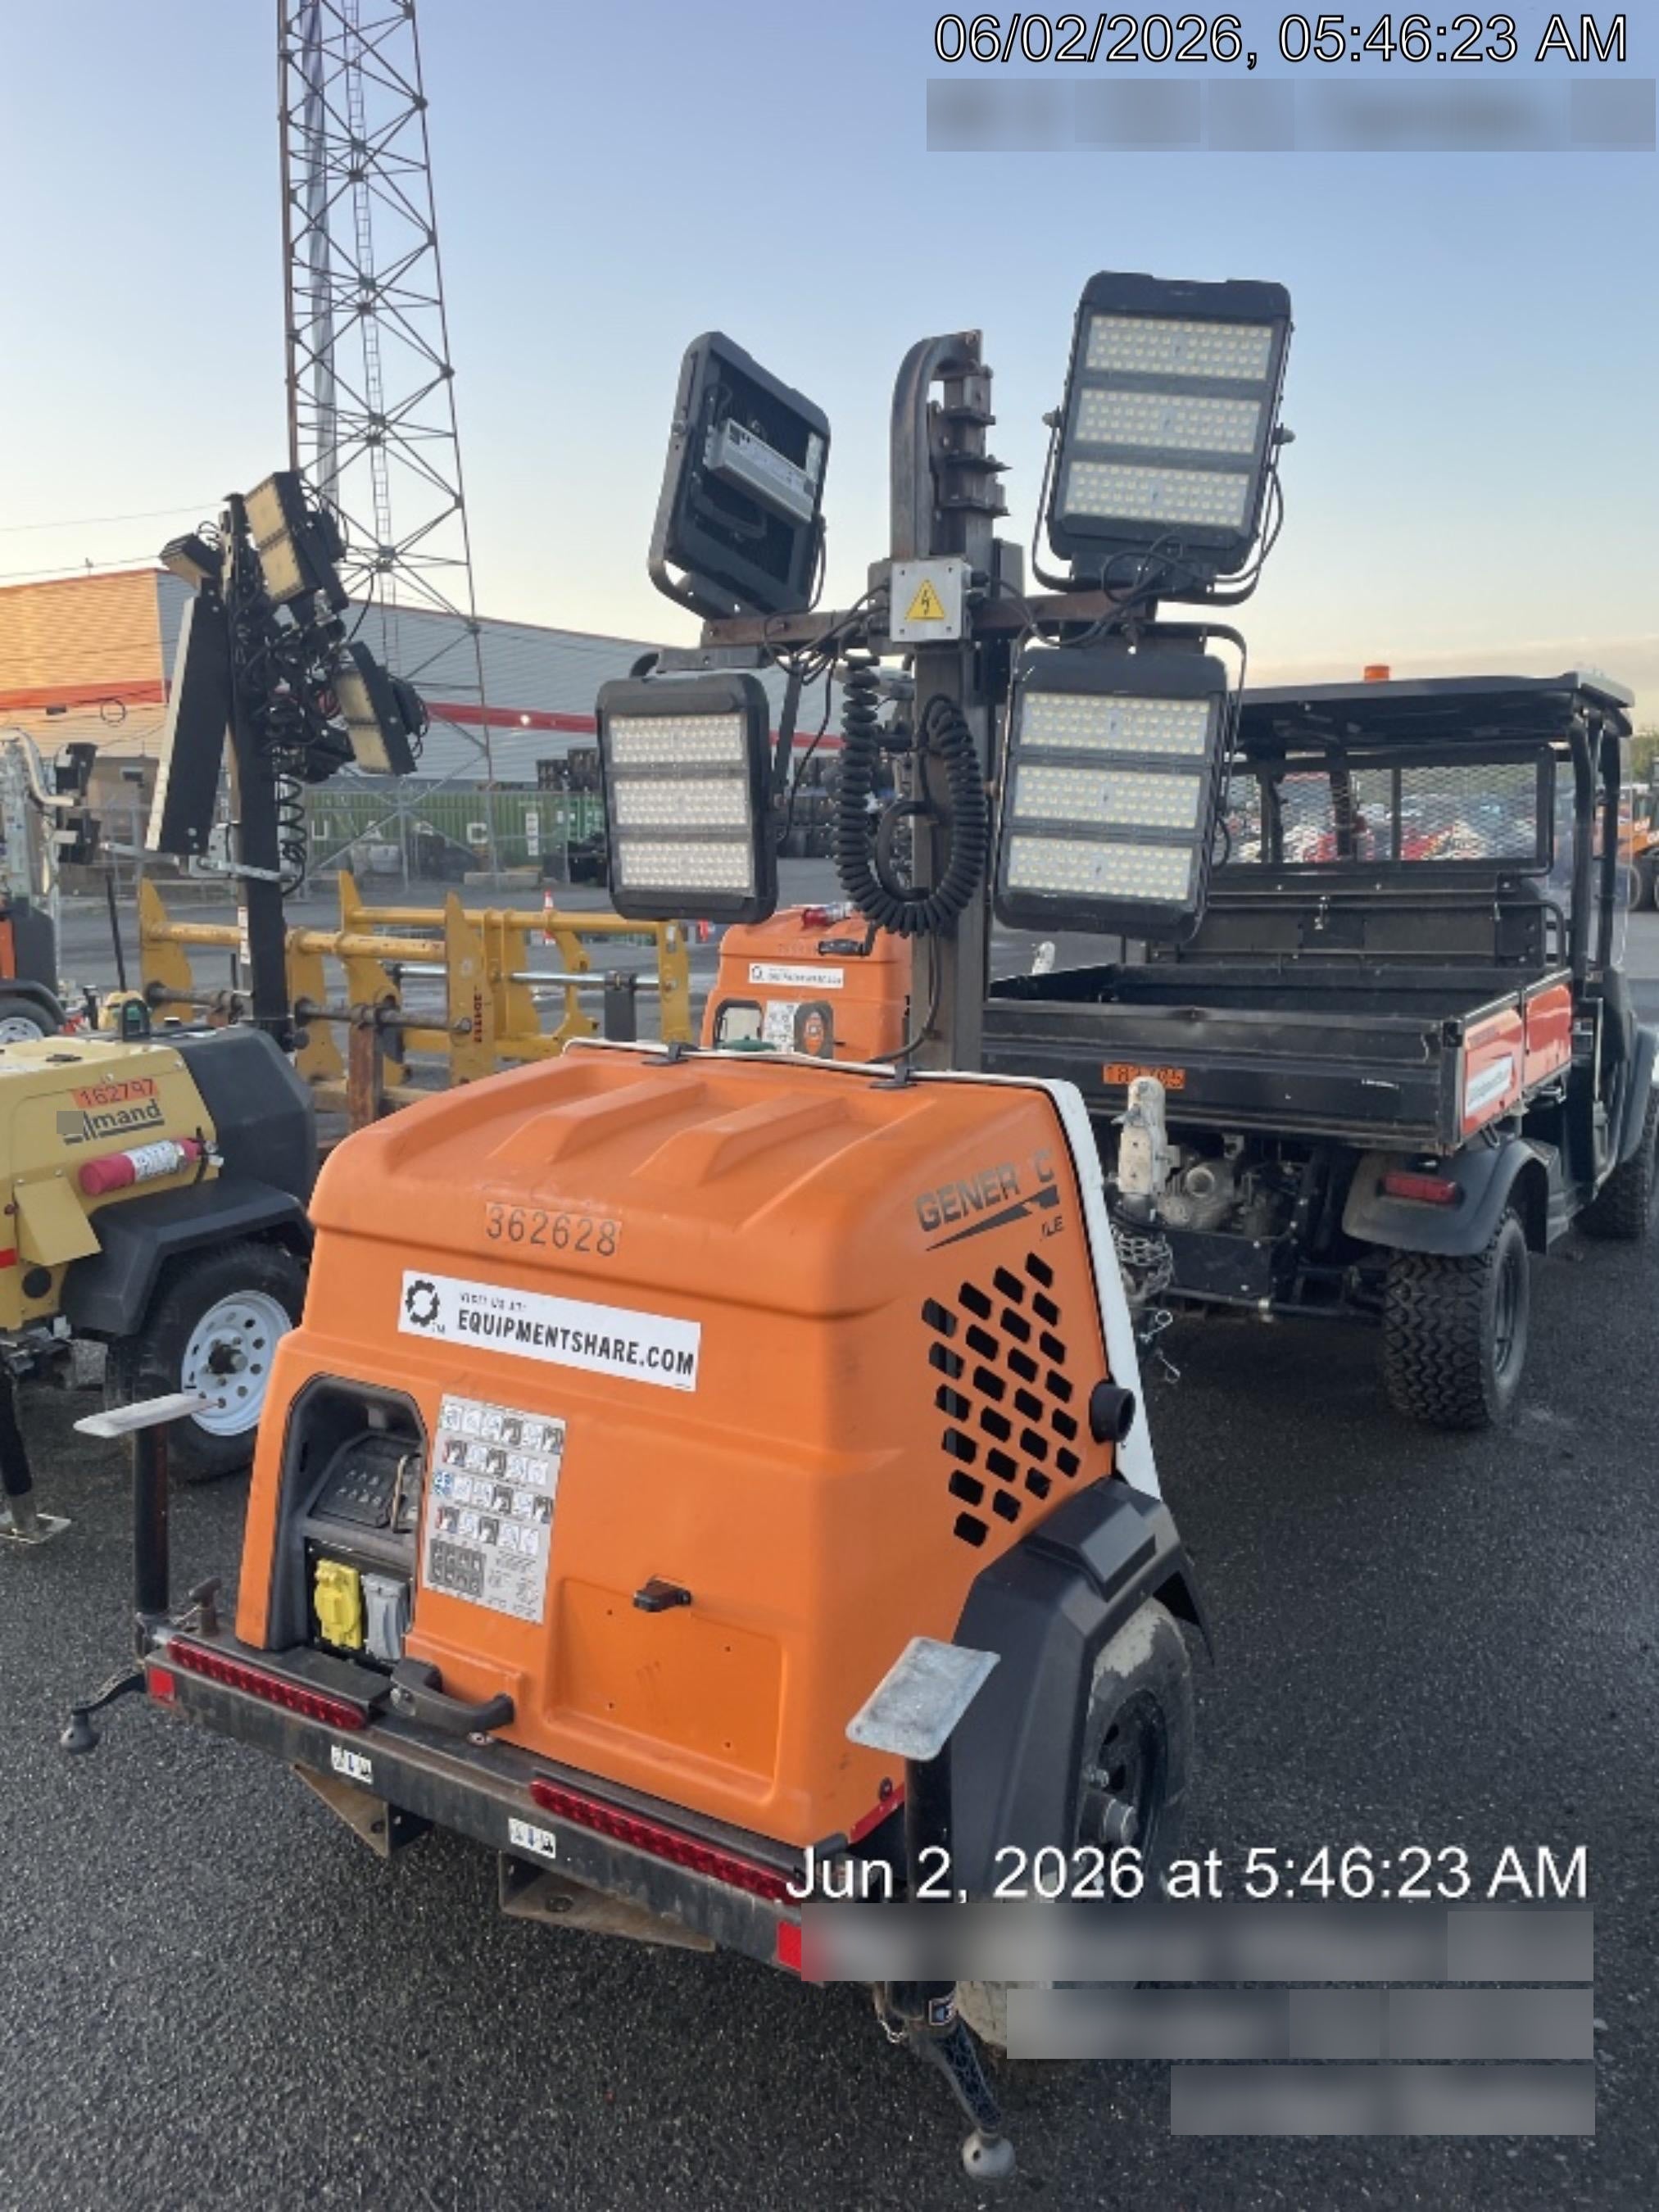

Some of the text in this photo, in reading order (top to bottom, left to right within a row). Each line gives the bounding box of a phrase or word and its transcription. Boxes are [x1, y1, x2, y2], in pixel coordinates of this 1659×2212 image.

[80, 1078, 154, 1105] 162797
[74, 1098, 163, 1140] llmand
[486, 1204, 616, 1257] 362628
[458, 1308, 695, 1376] EQUIPMENTSHARE.COM
